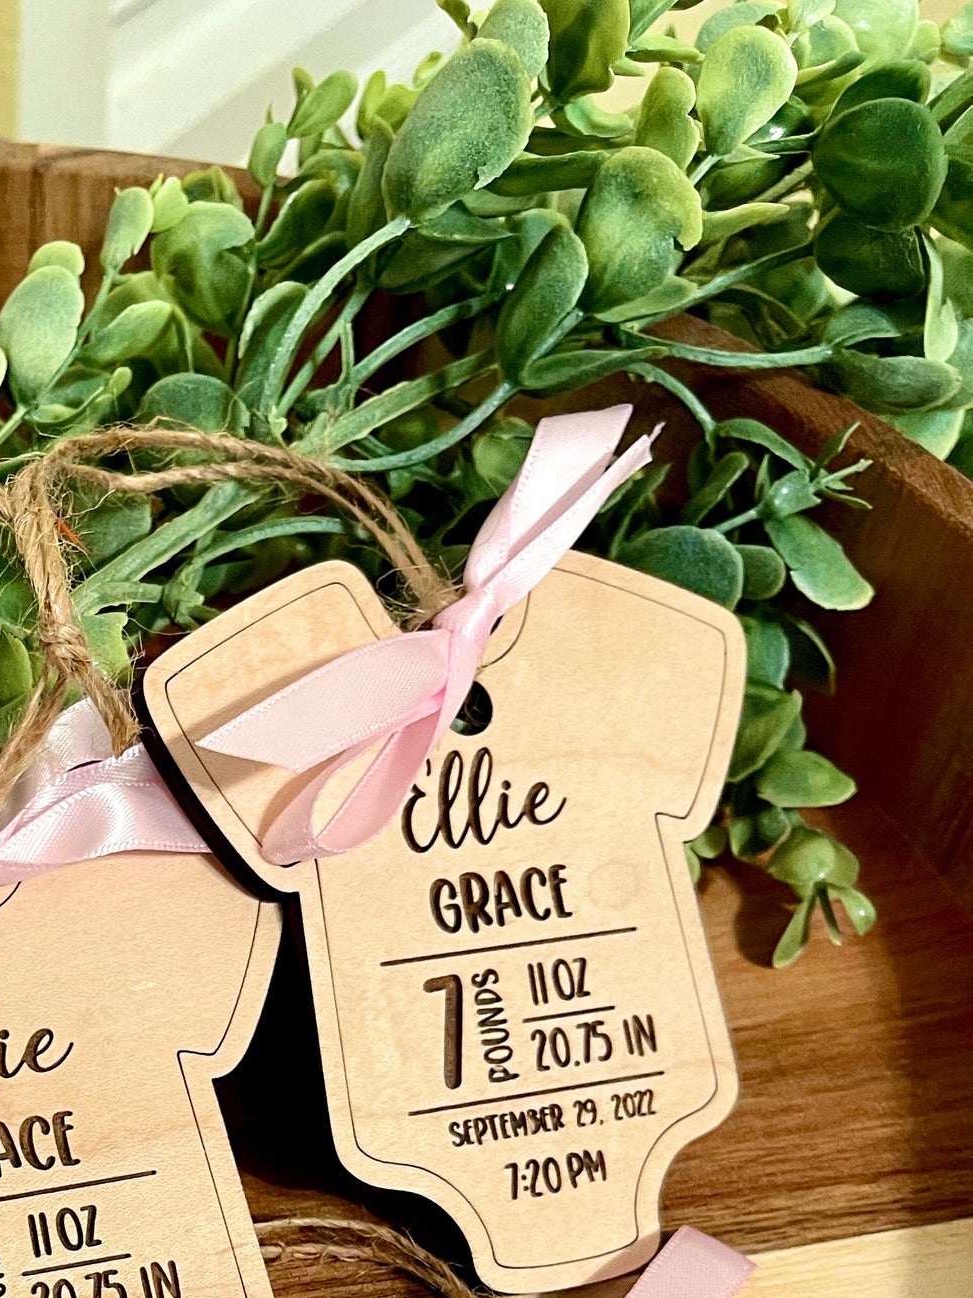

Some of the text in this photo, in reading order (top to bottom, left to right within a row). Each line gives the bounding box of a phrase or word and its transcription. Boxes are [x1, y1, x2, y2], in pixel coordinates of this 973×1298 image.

[429, 863, 573, 934] GRACE
[422, 974, 464, 1090] 7
[471, 968, 520, 1083] POUNDS
[530, 1014, 657, 1071] 20.75 IN
[448, 1103, 565, 1148] SEPTEMBER
[611, 1089, 656, 1121] 2022
[504, 1149, 608, 1201] 7:20 PM
